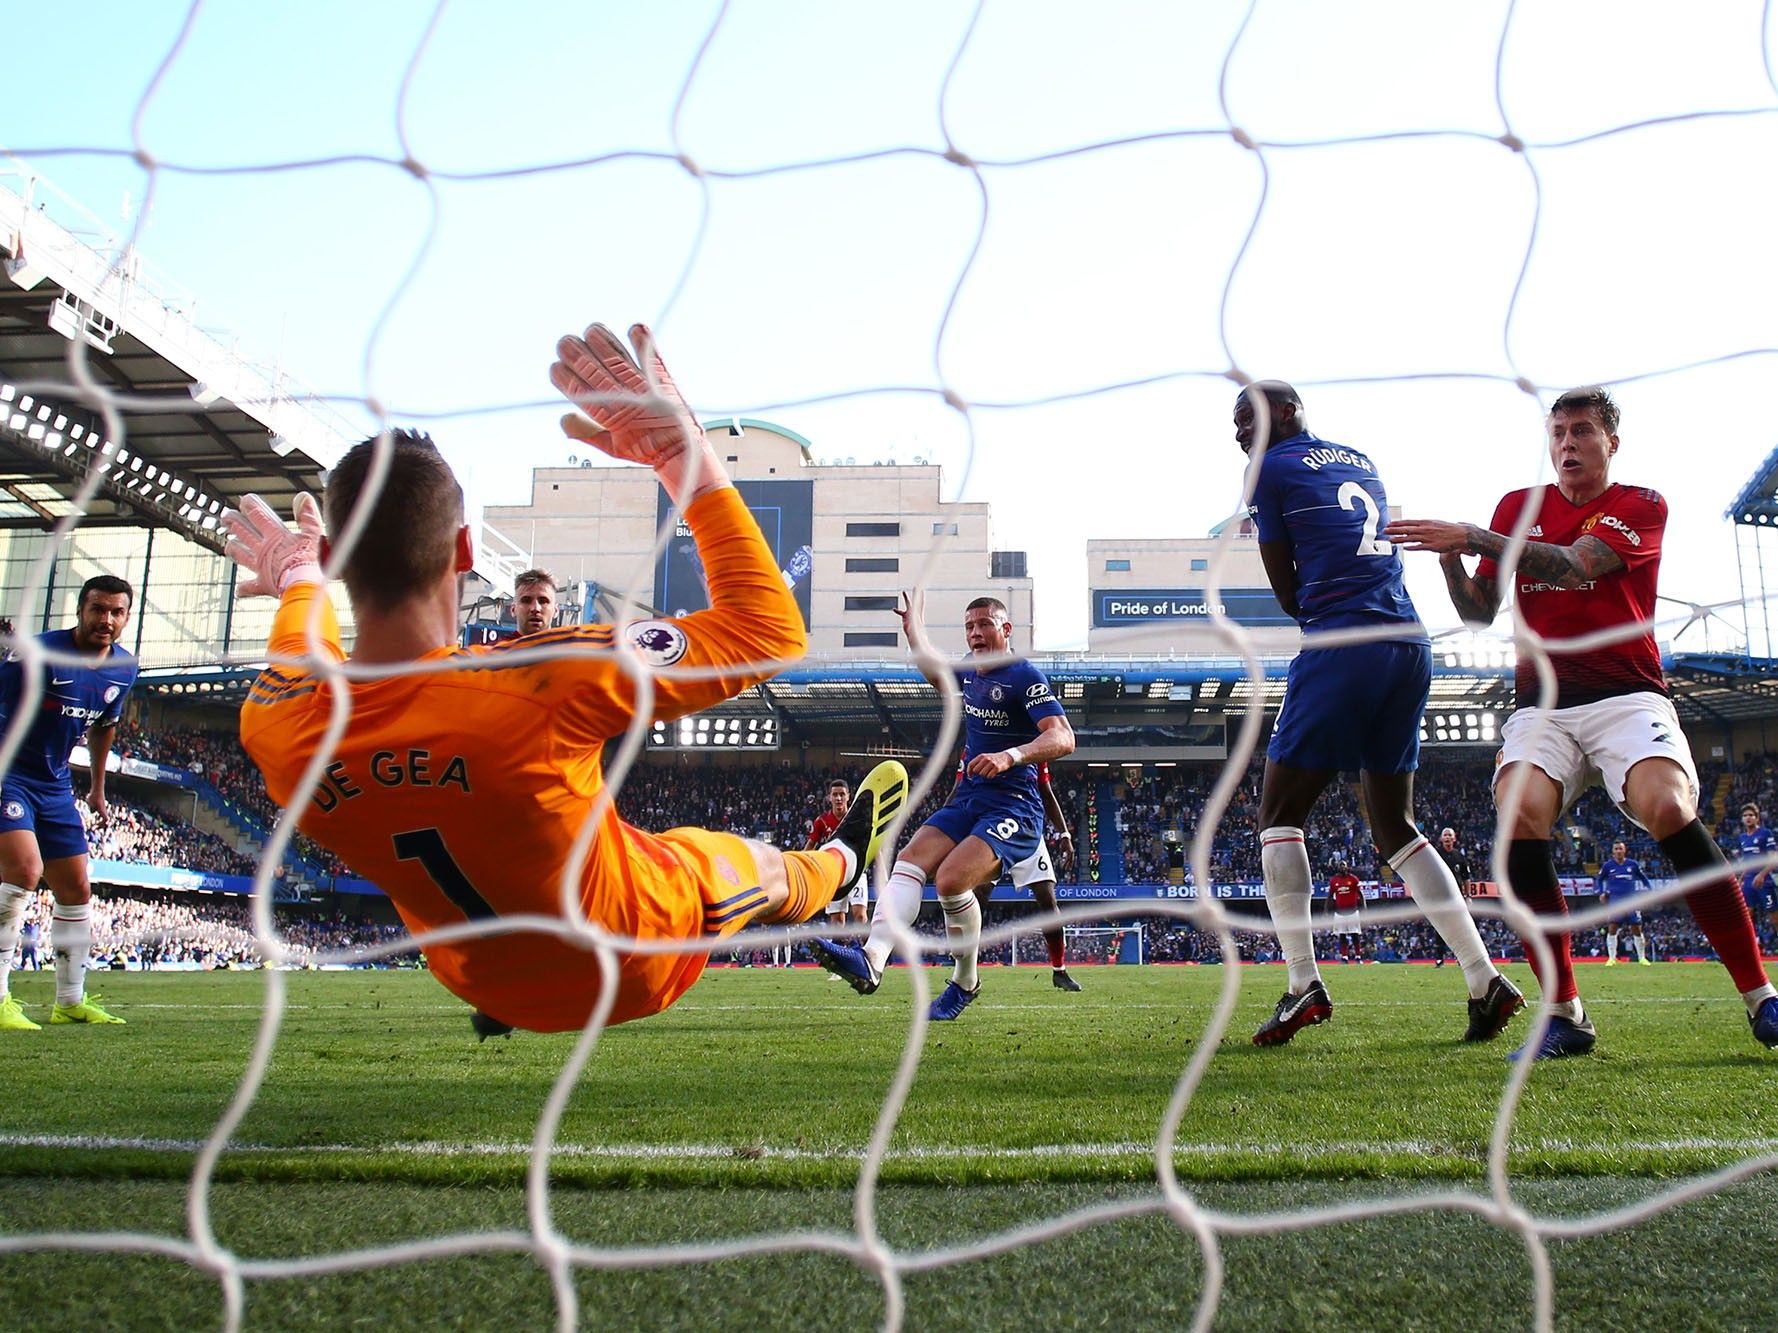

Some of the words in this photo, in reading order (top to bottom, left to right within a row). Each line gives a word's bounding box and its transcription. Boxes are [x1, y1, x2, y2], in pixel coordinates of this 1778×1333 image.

[1302, 447, 1372, 472] RÜDIGER
[1337, 481, 1393, 556] 2
[1111, 602, 1149, 614] Pride
[1152, 602, 1168, 614] of
[1171, 602, 1226, 614] London
[964, 703, 1009, 719] OKOHAMA
[984, 719, 1009, 727] TYRES
[370, 748, 472, 793] GEA
[996, 818, 1019, 839] 8
[1038, 856, 1048, 871] 6
[392, 826, 501, 925] 1
[1060, 888, 1073, 897] OF
[1075, 888, 1117, 897] LONDON
[1217, 885, 1232, 897] IS
[1766, 895, 1774, 906] 3
